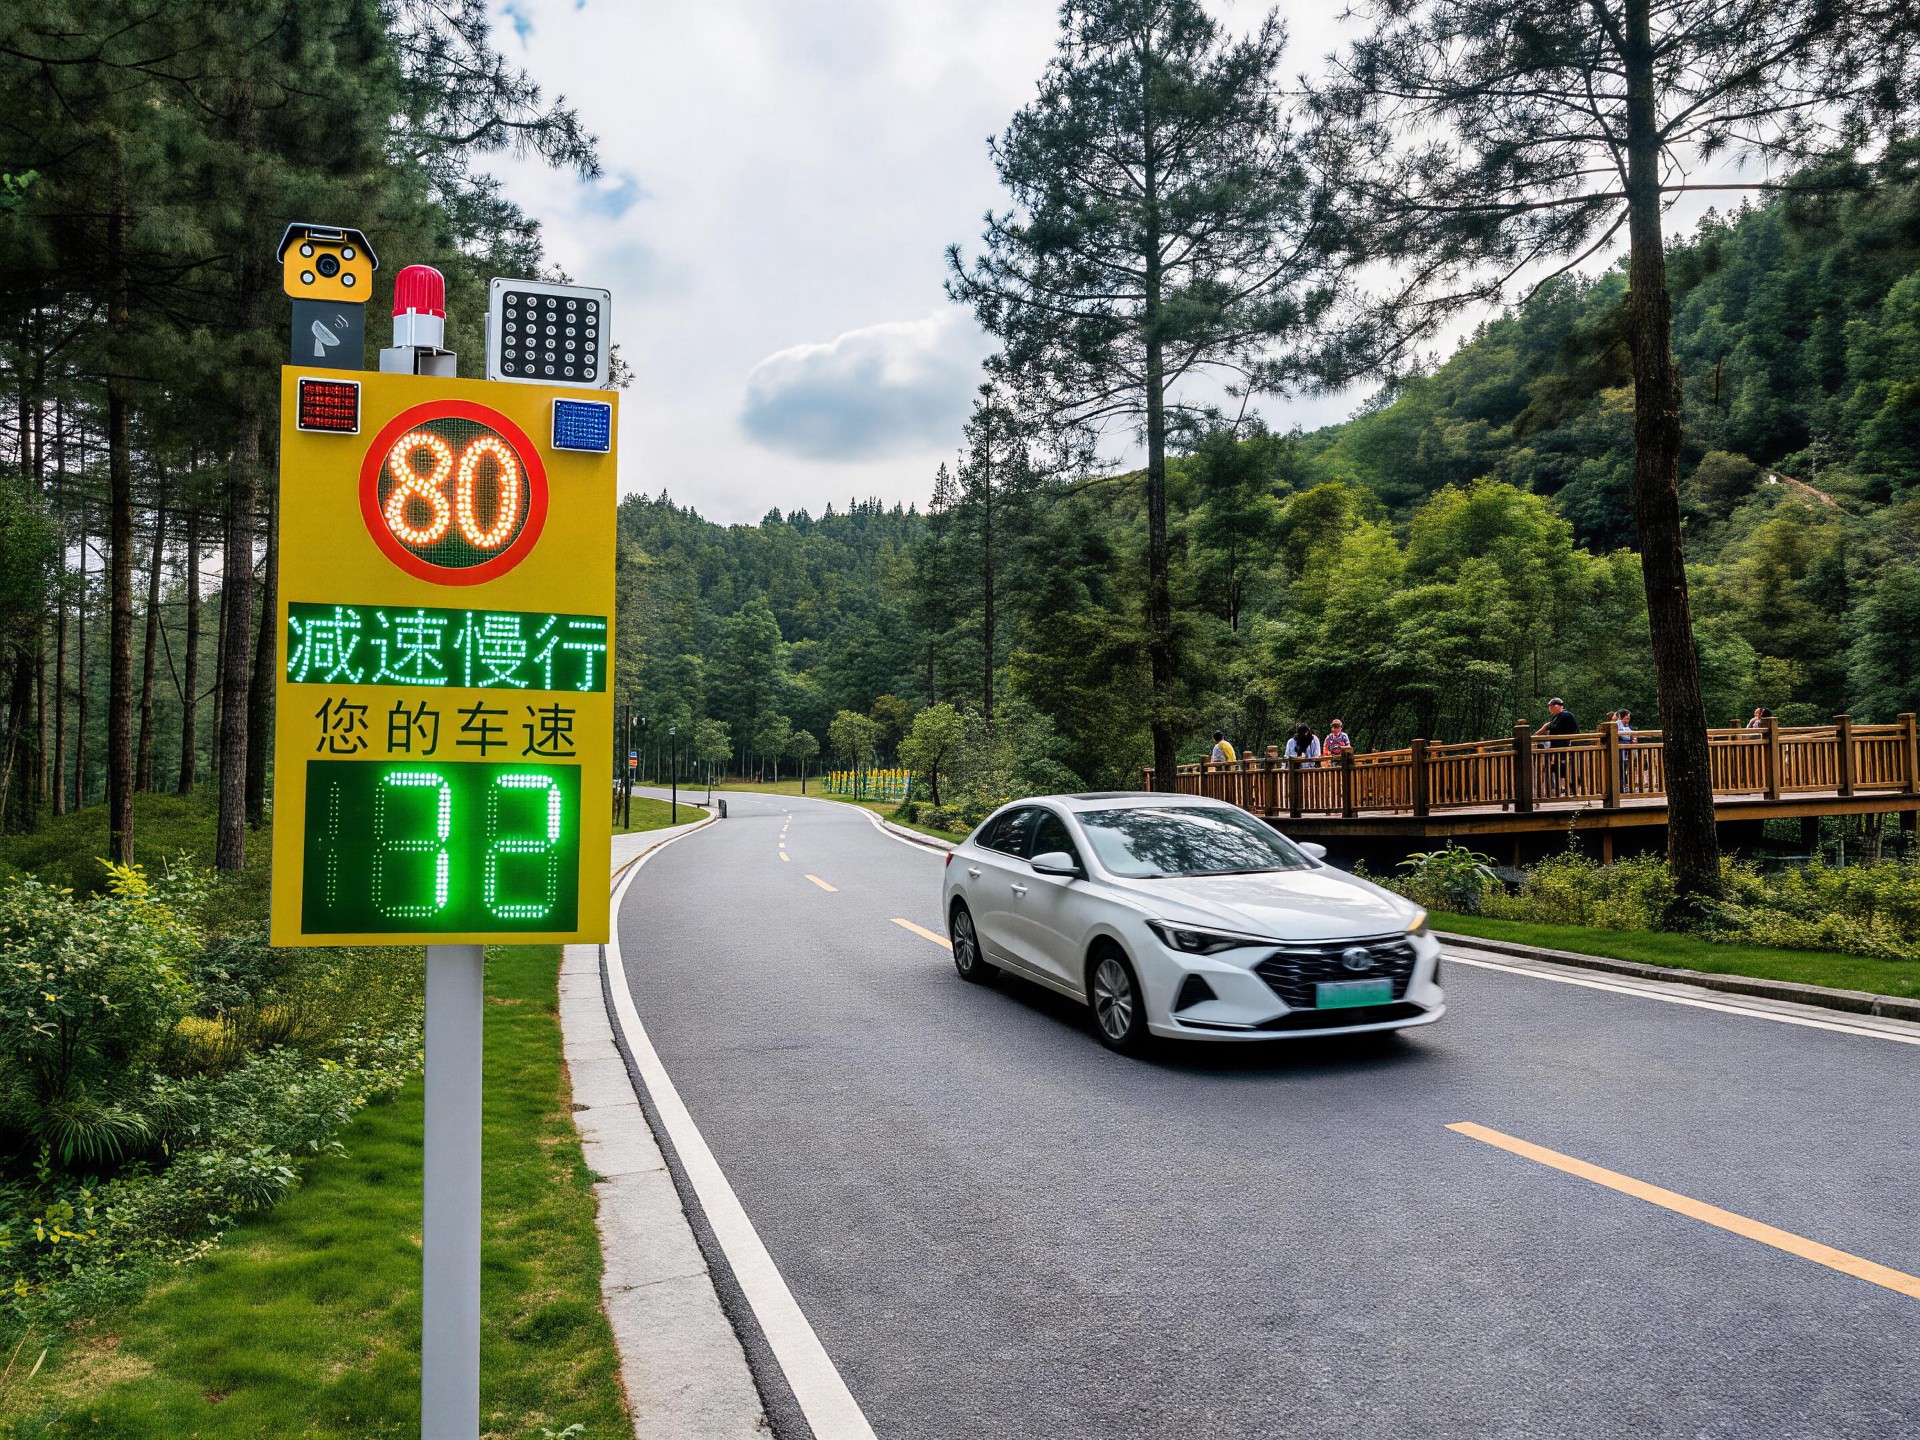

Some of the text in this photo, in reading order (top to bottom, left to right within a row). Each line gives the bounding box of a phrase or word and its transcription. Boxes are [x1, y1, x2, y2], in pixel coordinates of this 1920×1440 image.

[384, 432, 519, 548] 80
[287, 606, 607, 692] 减速慢行
[315, 697, 577, 757] 您的车速
